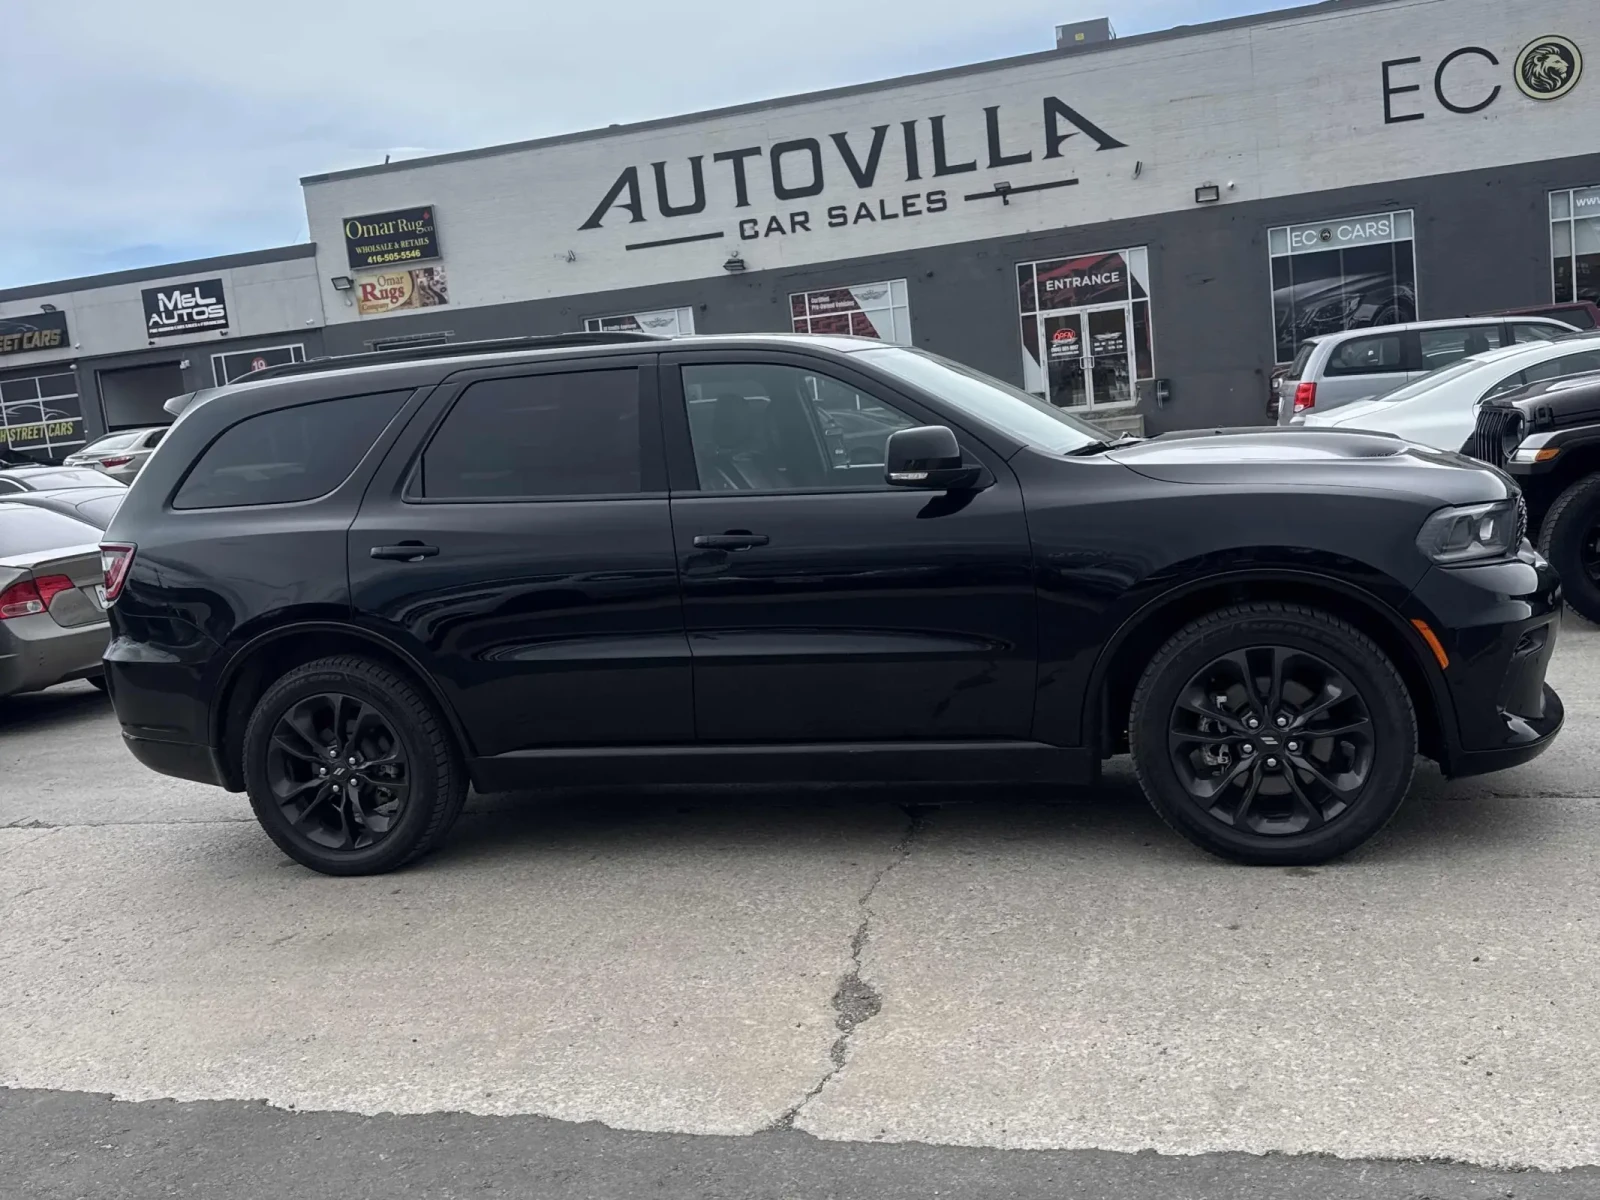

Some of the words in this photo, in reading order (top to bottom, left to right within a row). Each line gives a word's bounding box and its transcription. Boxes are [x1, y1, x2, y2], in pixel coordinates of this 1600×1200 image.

[577, 96, 1129, 232] AUTOVILLA
[739, 210, 811, 240] CAR
[827, 190, 947, 227] SALES
[346, 220, 396, 239] Omar
[397, 219, 424, 234] Rug
[1337, 220, 1390, 240] CARS
[400, 237, 429, 248] RETAILS
[367, 249, 421, 264] 416-505-5546
[378, 275, 404, 287] Omar
[1046, 272, 1119, 291] ENTRANCE
[157, 287, 216, 312] M&L
[359, 282, 405, 304] Rugs
[149, 304, 225, 327] AUTOS
[23, 329, 61, 349] CARS
[1053, 331, 1074, 342] OPEN
[252, 360, 266, 371] 19
[10, 425, 44, 441] STREET
[49, 422, 73, 437] CARS
